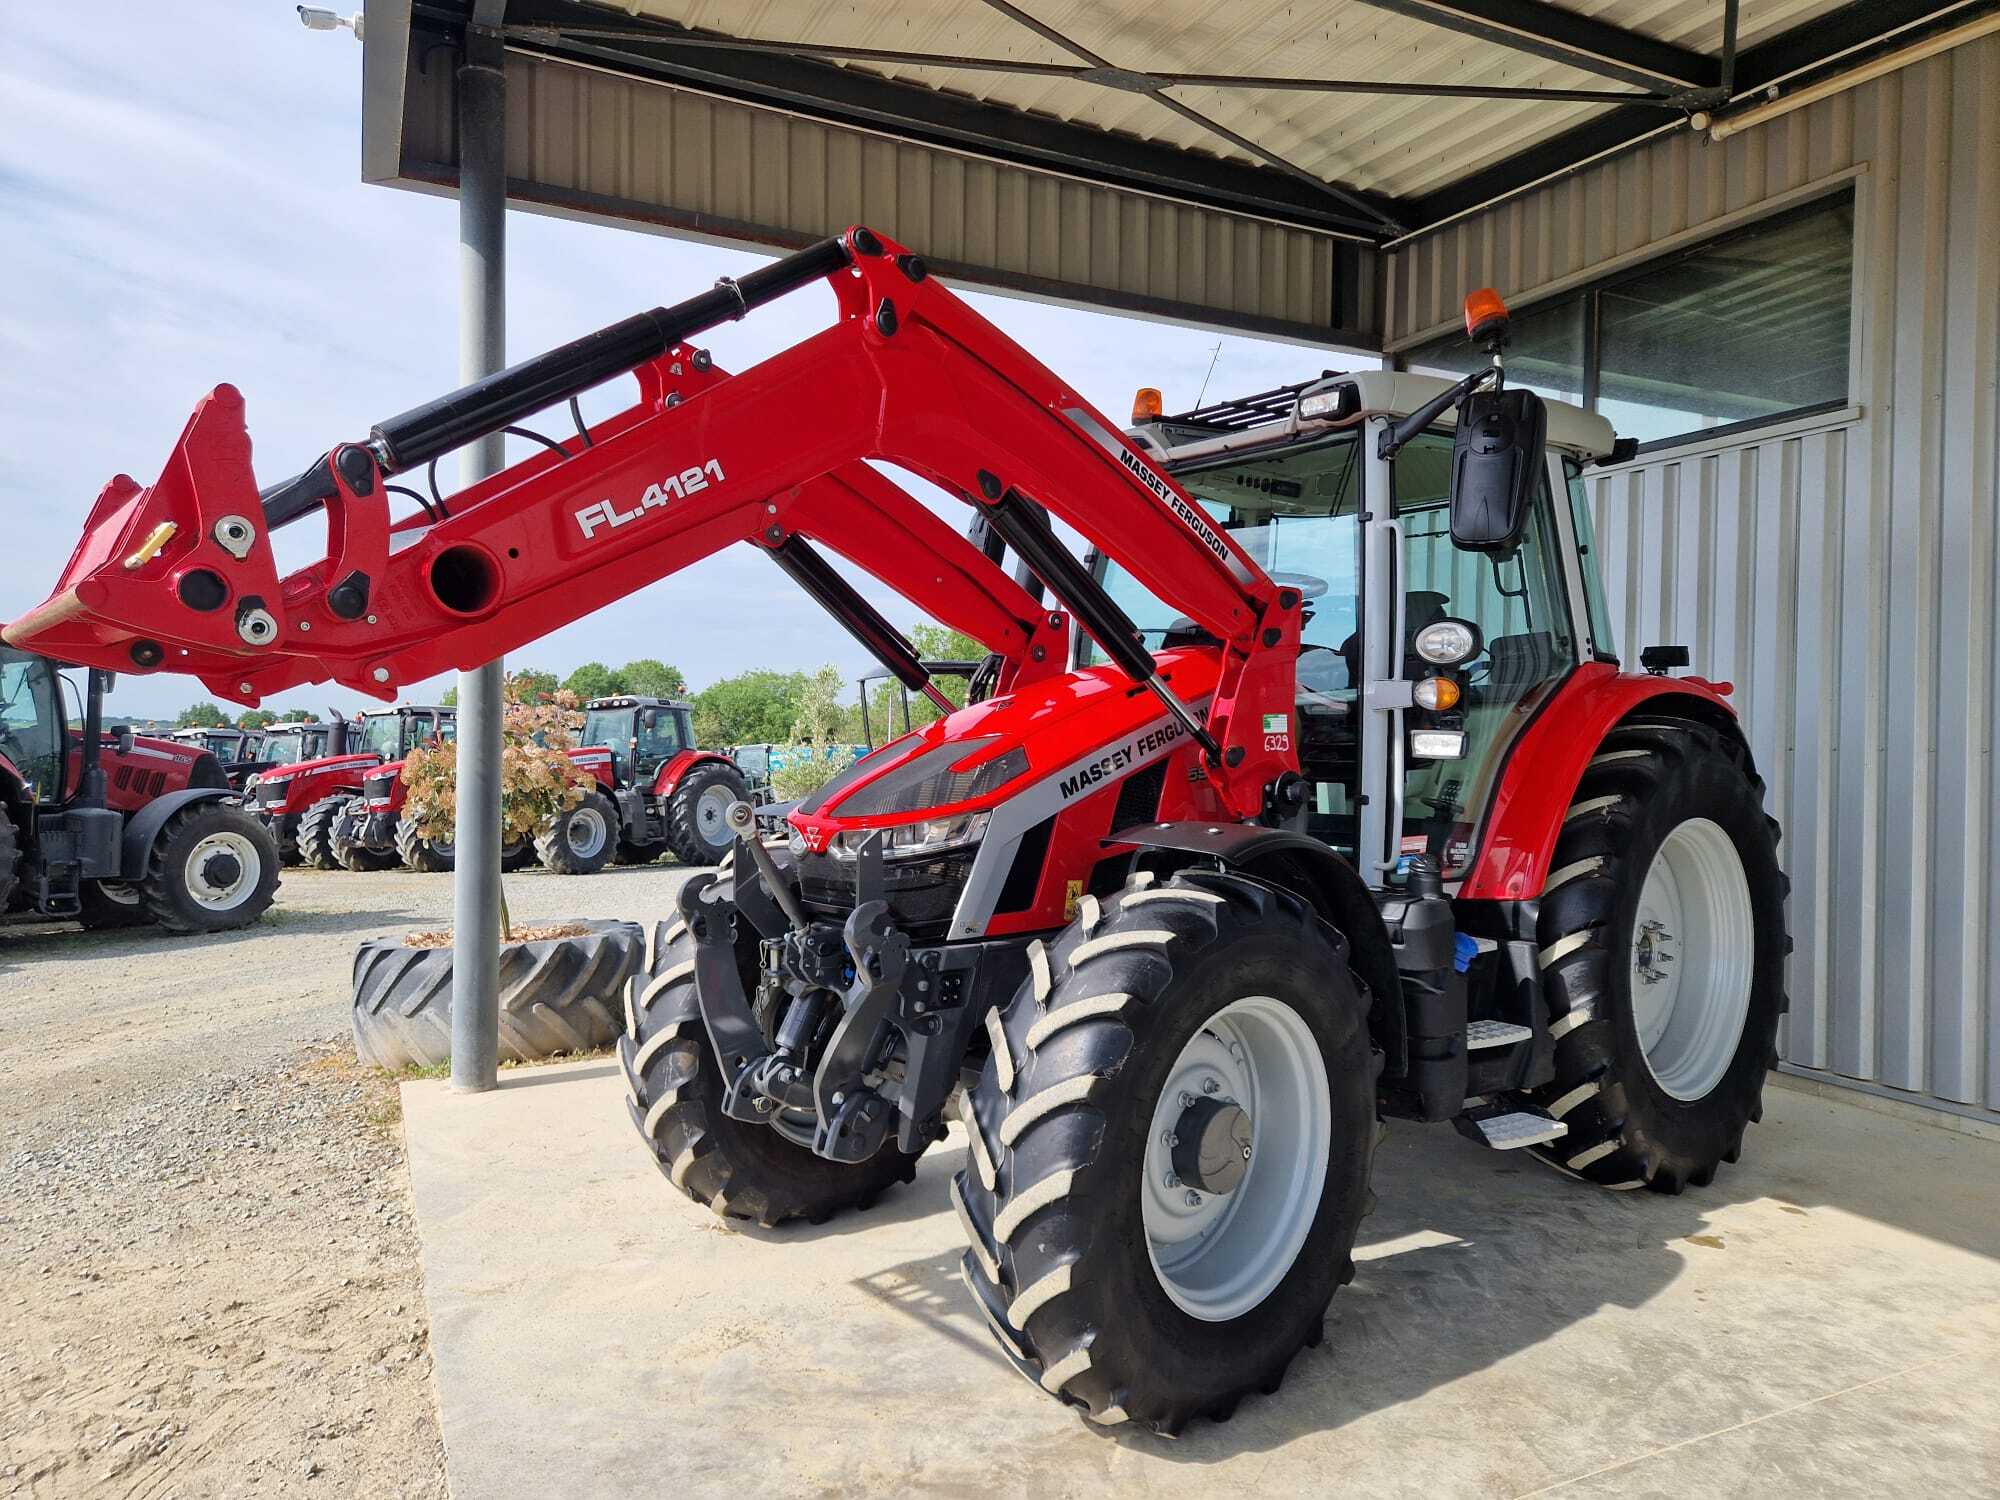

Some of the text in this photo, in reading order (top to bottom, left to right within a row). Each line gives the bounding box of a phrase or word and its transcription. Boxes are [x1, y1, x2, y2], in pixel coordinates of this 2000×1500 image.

[575, 459, 725, 539] FL.4121
[1120, 449, 1228, 560] MASSEY FERGUSON
[1060, 706, 1209, 799] MASSEY FERGUN
[1264, 735, 1289, 751] 6329
